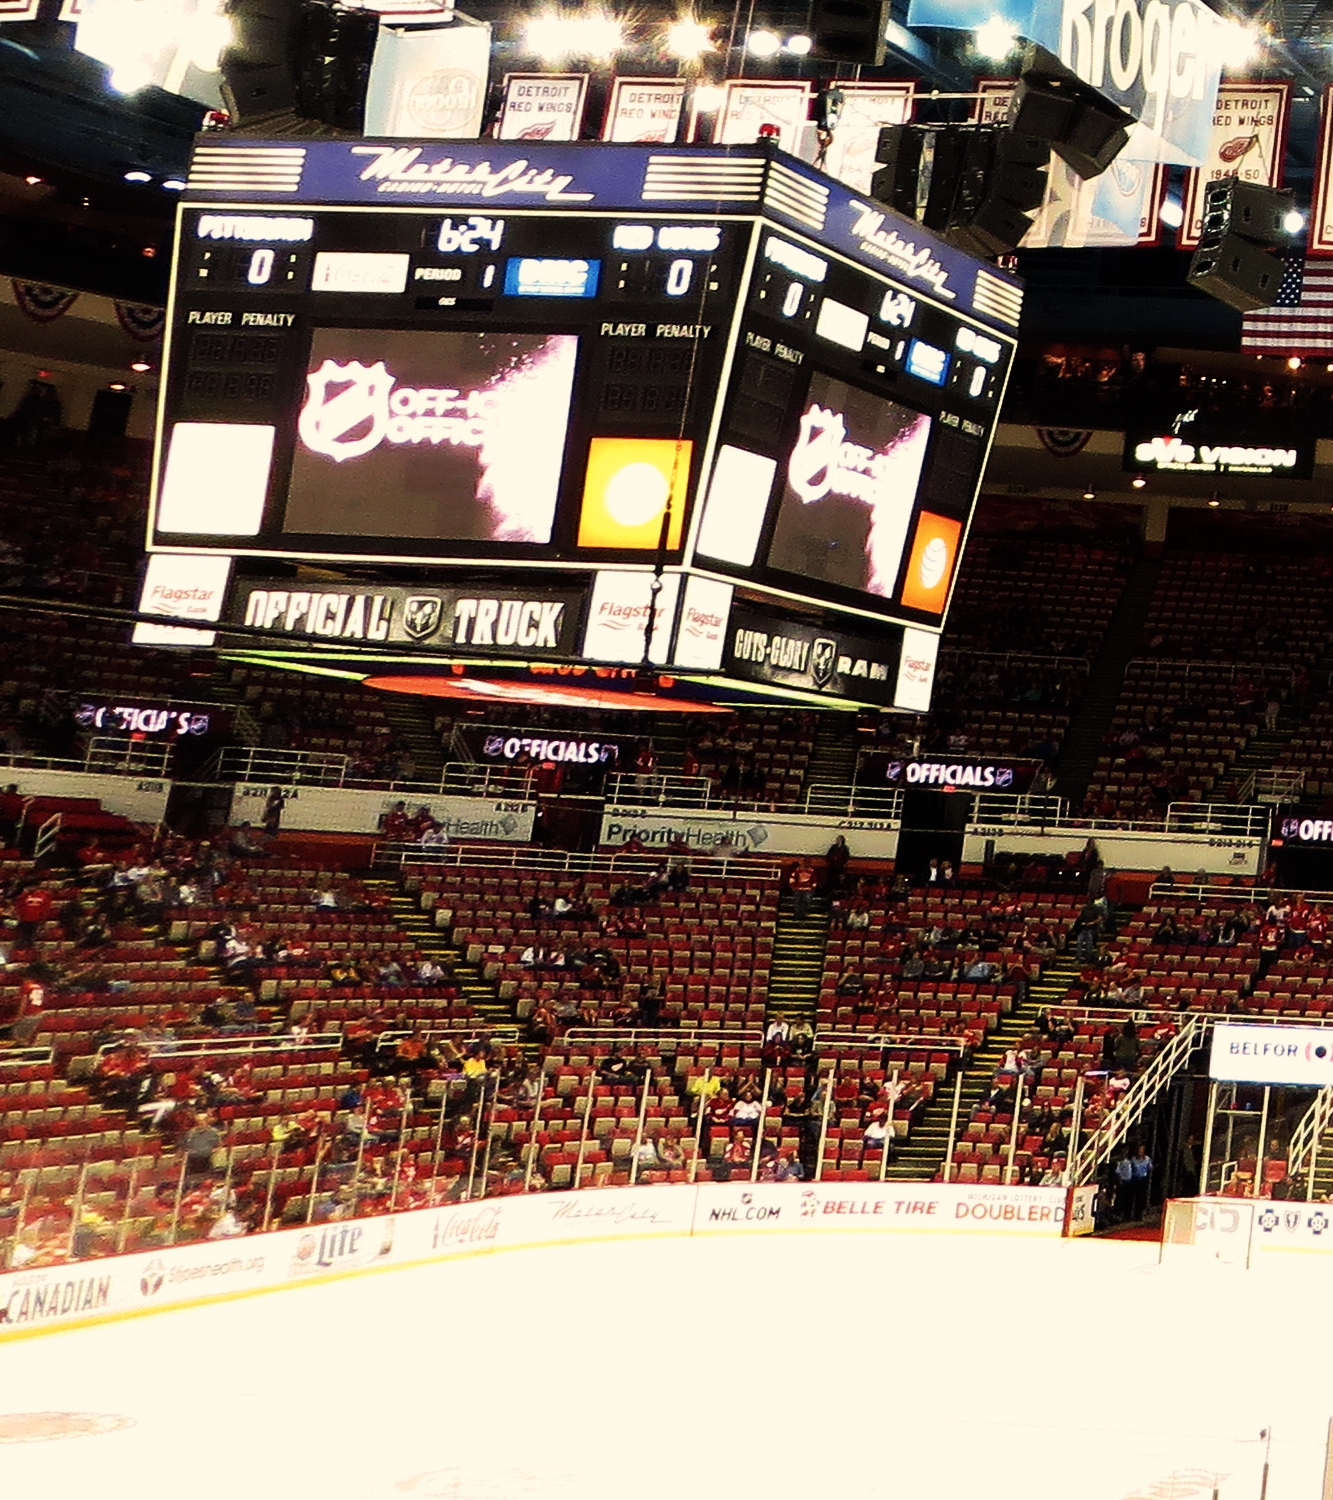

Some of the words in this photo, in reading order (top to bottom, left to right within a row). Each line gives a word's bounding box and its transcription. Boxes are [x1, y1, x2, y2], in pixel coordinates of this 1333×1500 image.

[439, 217, 504, 252] 6:24
[248, 250, 274, 284] 0
[414, 268, 462, 280] PERIOD
[666, 260, 693, 296] 0
[188, 312, 232, 324] PLAYER
[242, 312, 295, 326] PENALTY
[601, 323, 645, 337] PLAYER
[656, 325, 711, 338] PENALTY
[245, 590, 393, 640] OFFICIAL
[455, 599, 564, 648] TRUCK
[906, 762, 994, 787] OFFICIALS
[1230, 1042, 1298, 1056] BELFOR
[709, 1206, 780, 1221] NHL.COM
[823, 1200, 883, 1215] BELLE
[894, 1200, 939, 1215] TIRE
